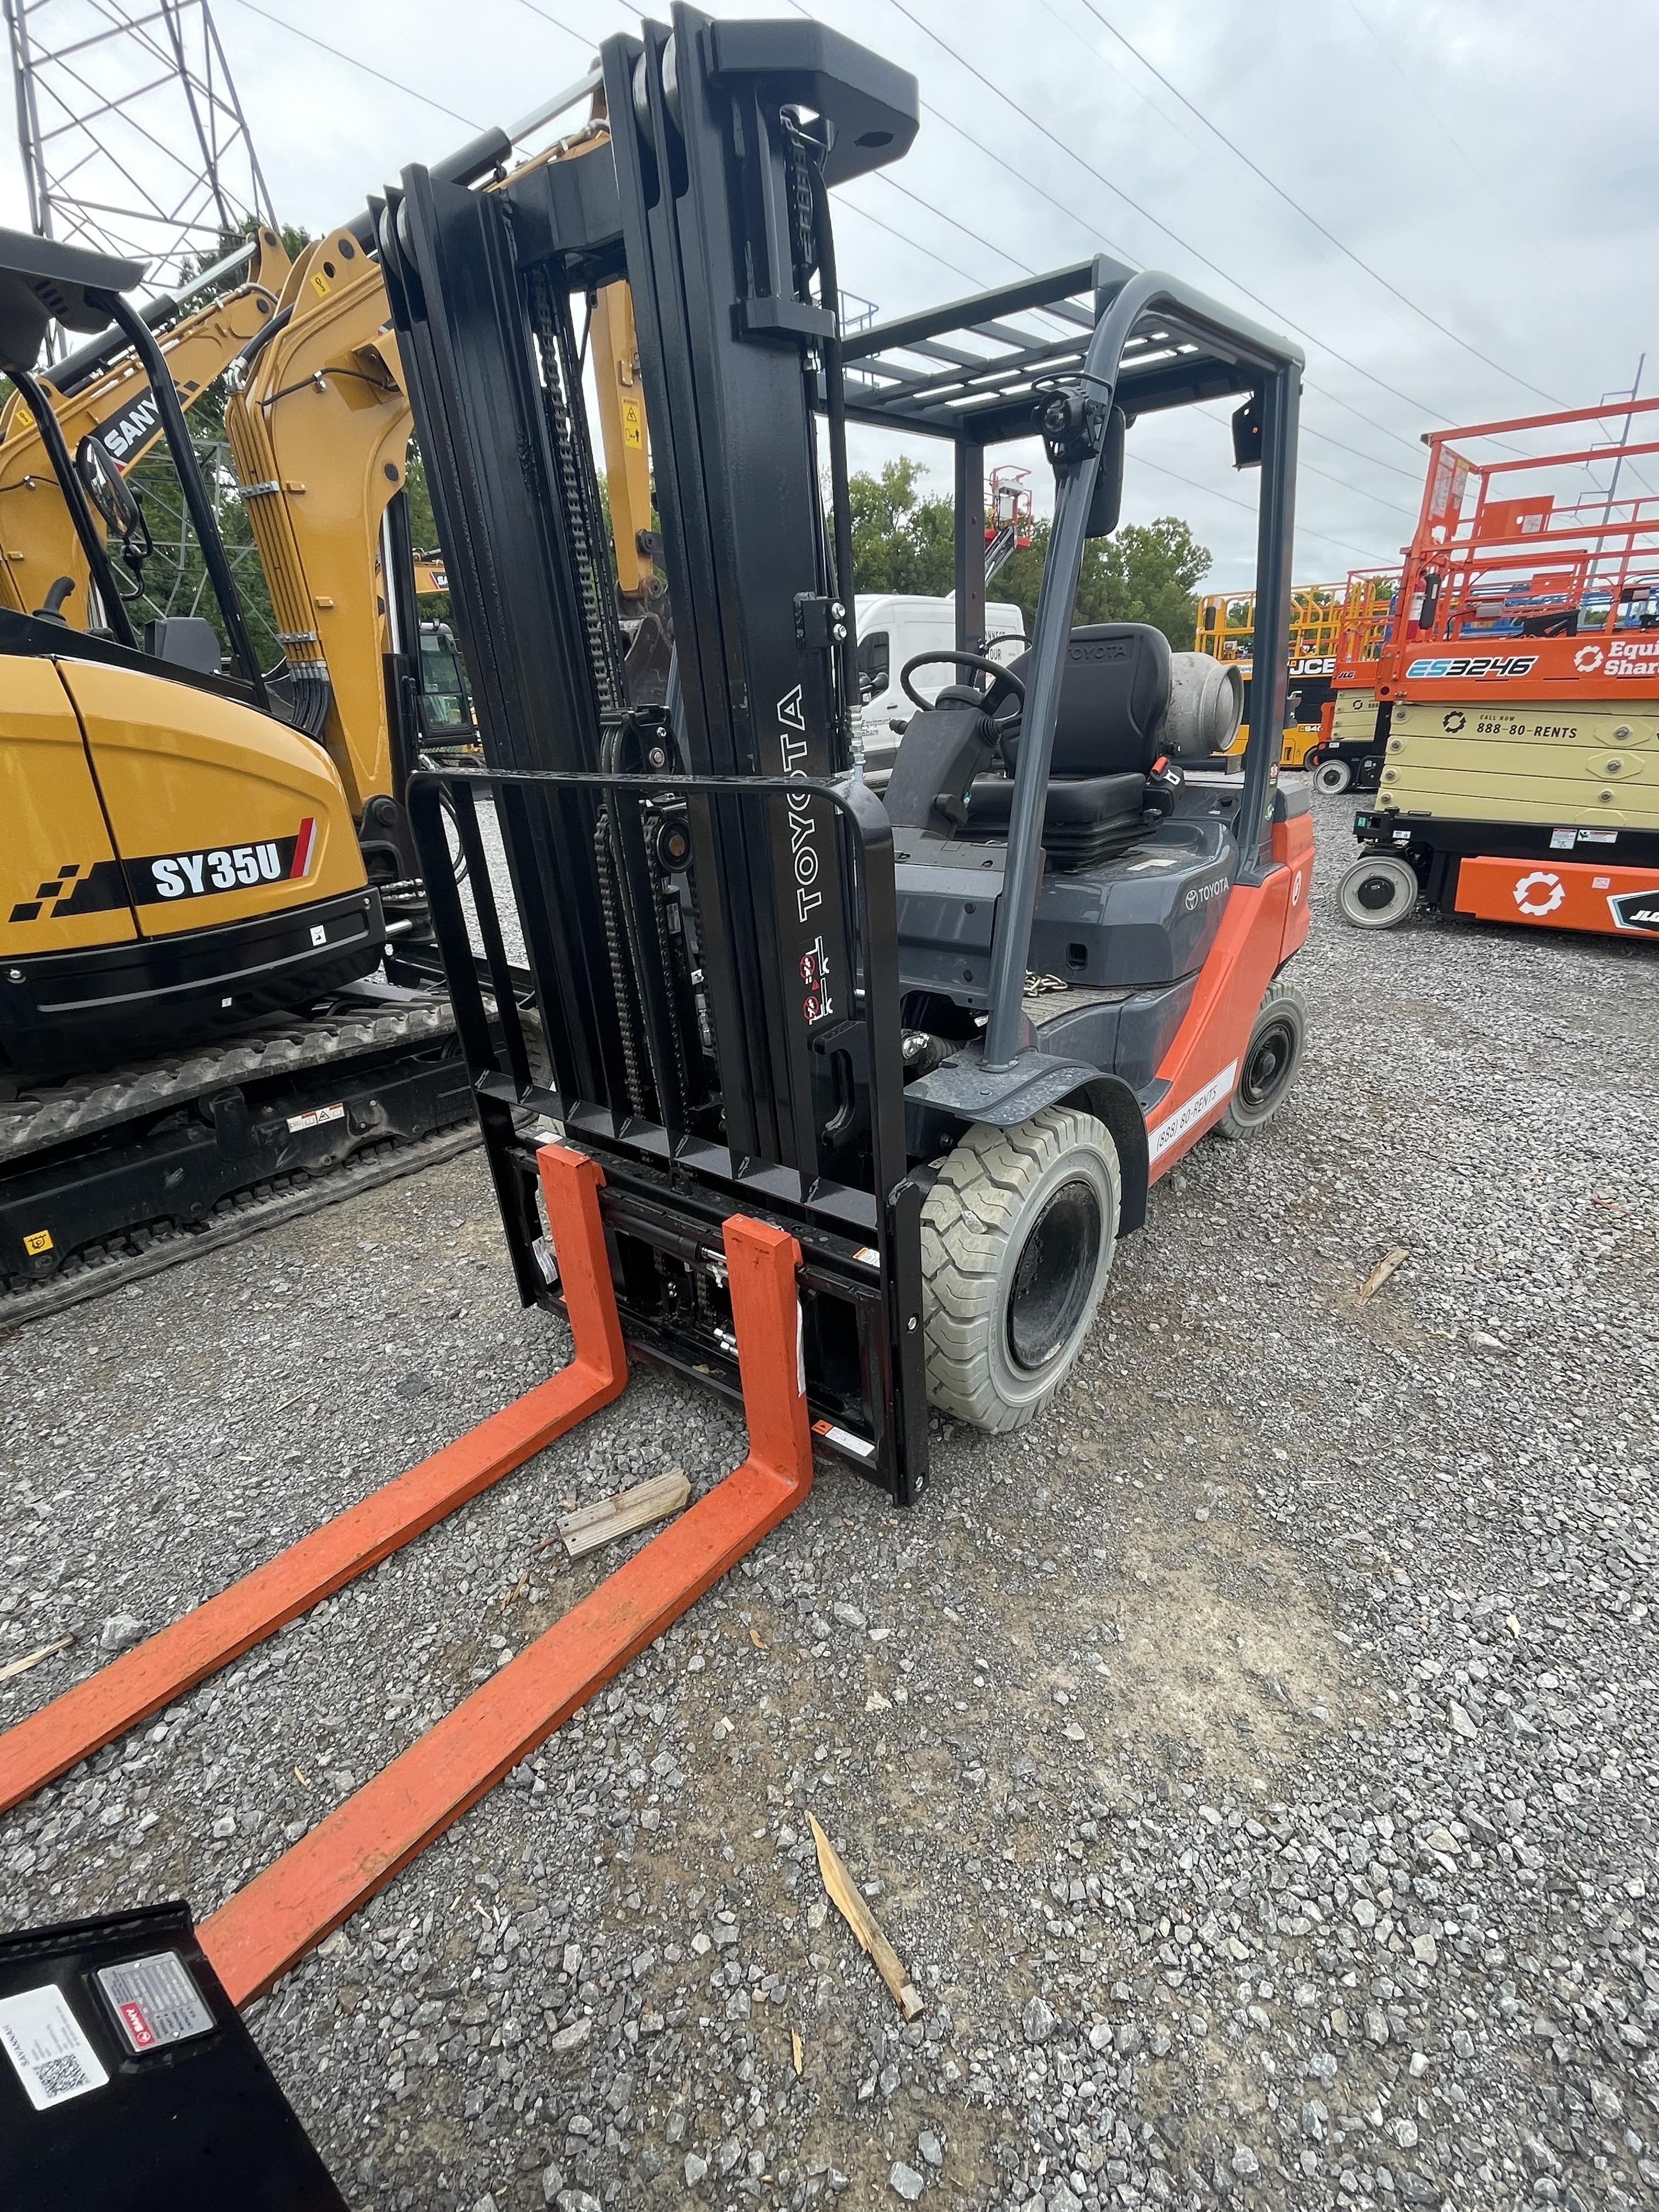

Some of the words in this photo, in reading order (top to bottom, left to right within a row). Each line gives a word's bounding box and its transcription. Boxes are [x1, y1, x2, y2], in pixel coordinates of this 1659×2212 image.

[103, 392, 160, 457] SANY
[437, 575, 449, 585] SA
[1607, 640, 1659, 660] Equi
[1406, 656, 1538, 678] ES3246
[1604, 659, 1659, 675] Shar
[1477, 723, 1578, 738] 888-80-RENTS
[777, 684, 822, 922] TOYOTA
[151, 843, 281, 898] SY35U
[1198, 877, 1229, 903] TOYOTA
[1156, 1119, 1178, 1152] (888)
[1180, 1084, 1218, 1128] 80-RENTS
[2, 2024, 30, 2067] SAVANNAH
